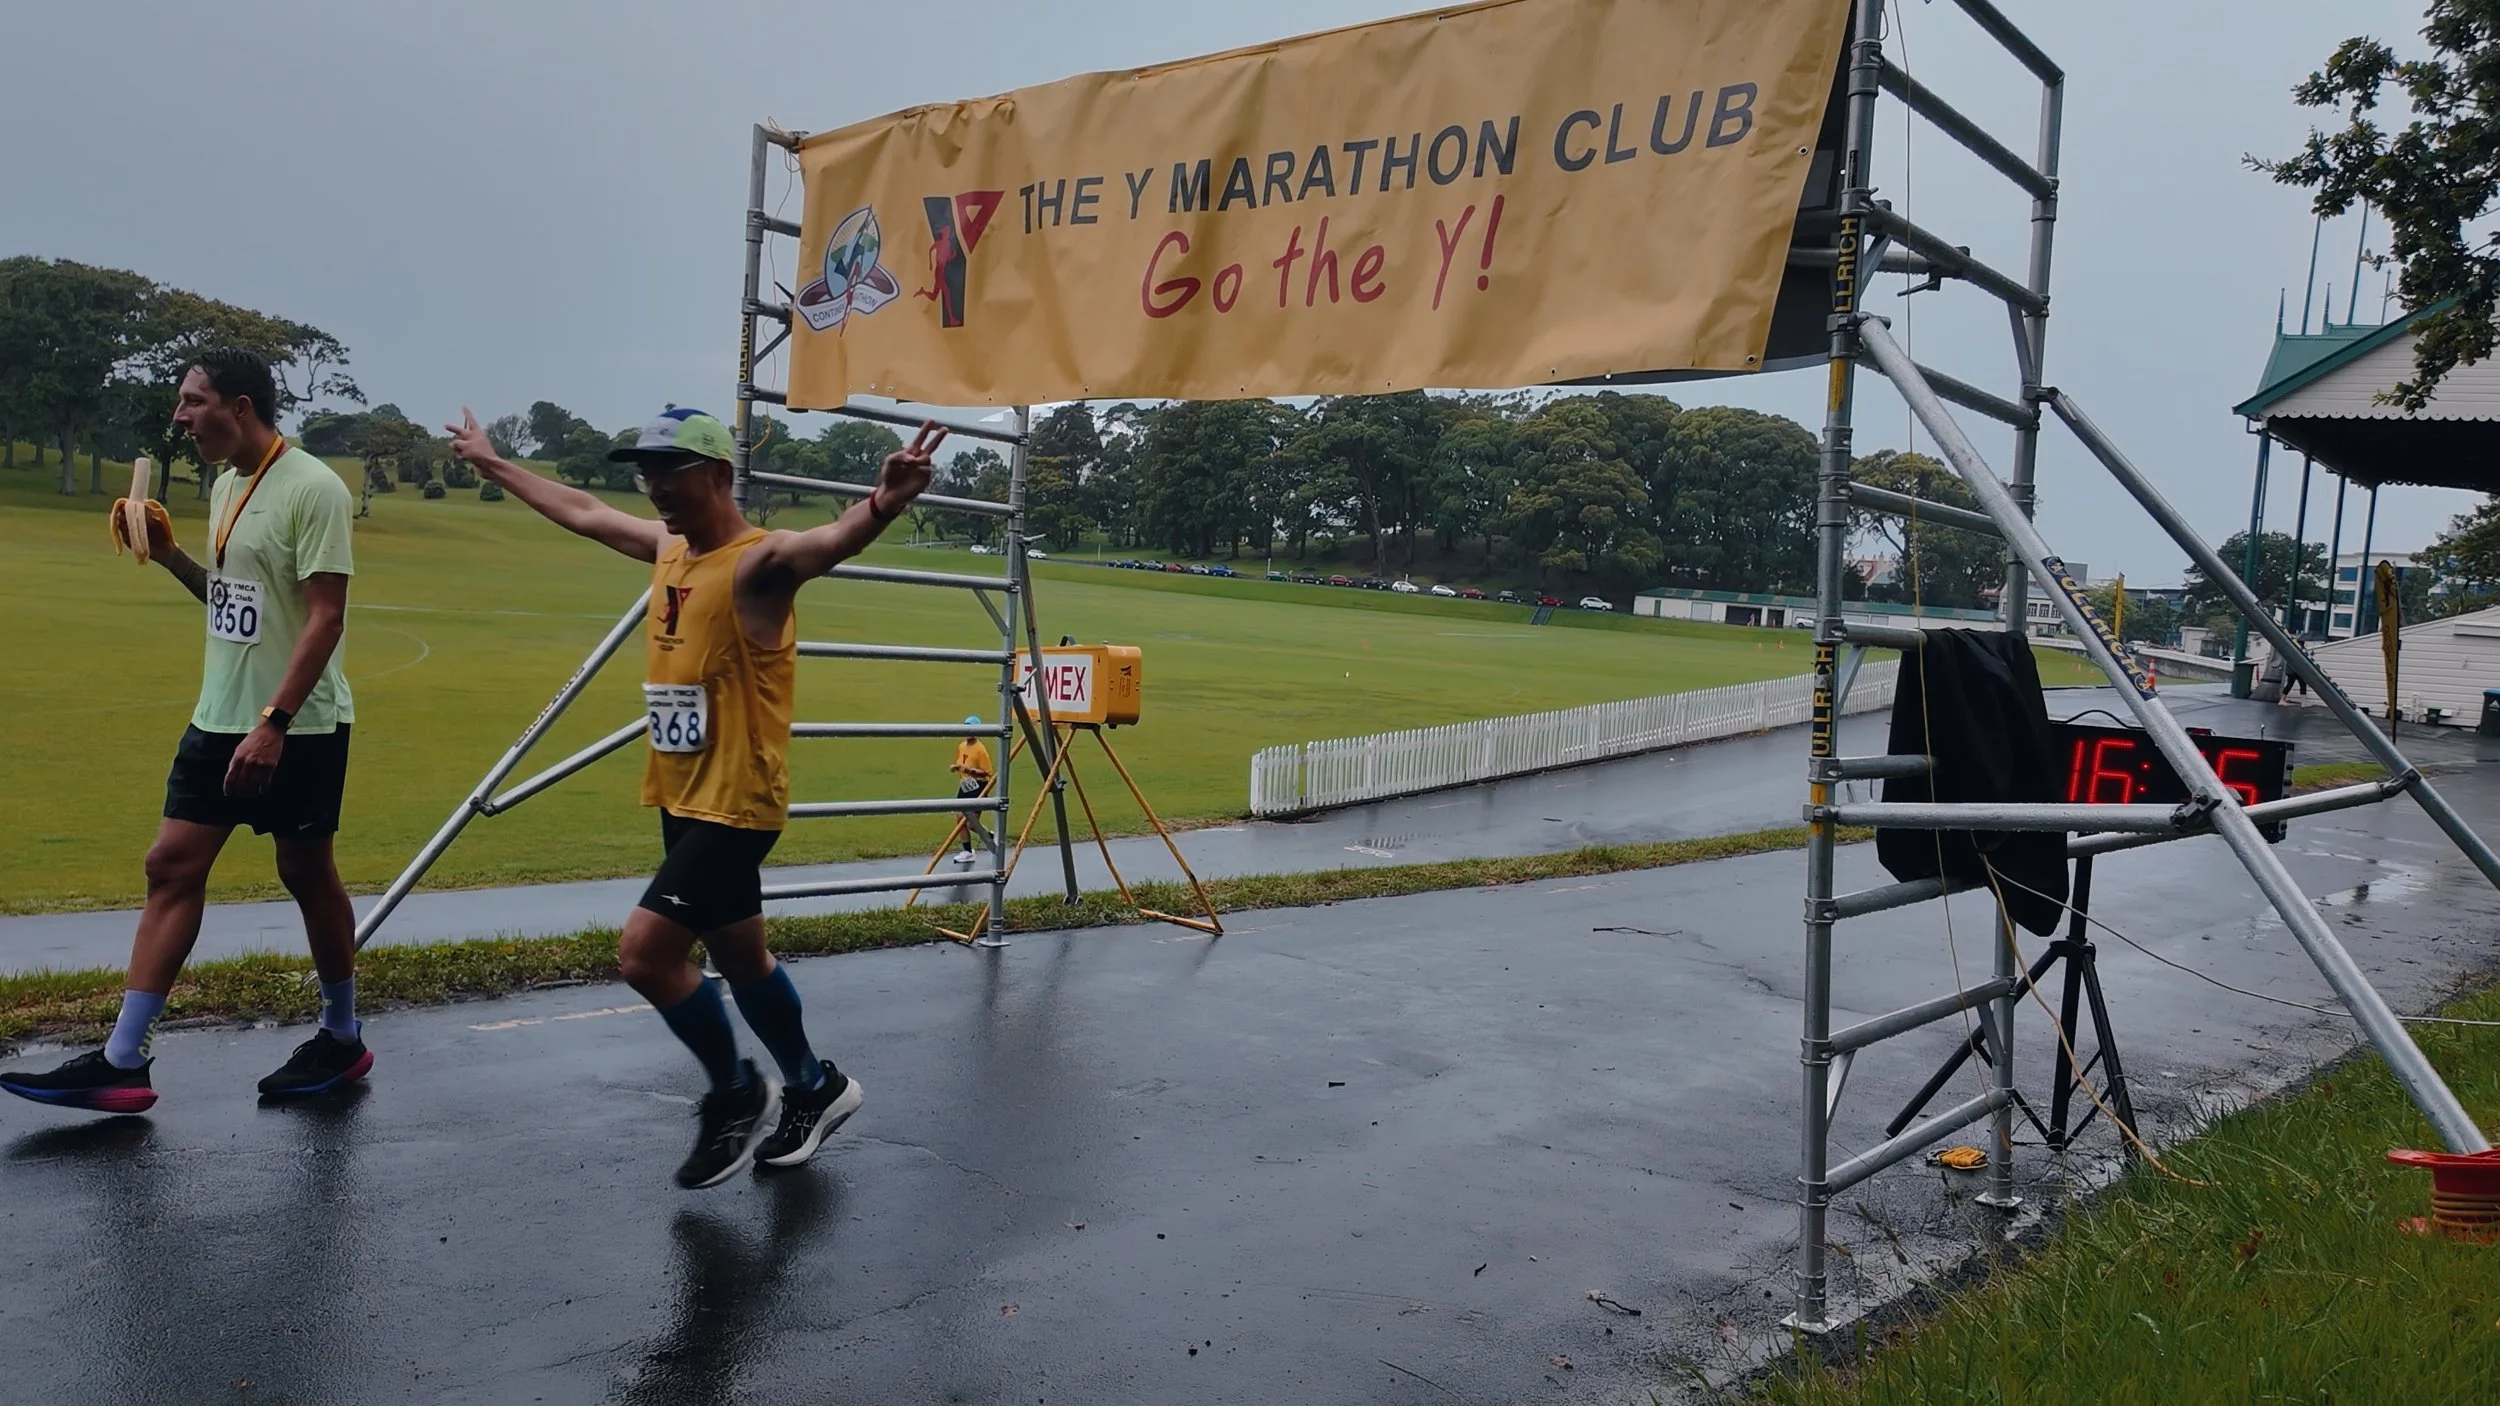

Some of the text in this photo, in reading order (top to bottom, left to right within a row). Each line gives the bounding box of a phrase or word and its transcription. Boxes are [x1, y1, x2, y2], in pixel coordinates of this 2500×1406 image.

[1020, 81, 1758, 235] THE Y MARATHON CLUB
[1141, 194, 1505, 319] Go the Y!
[1833, 217, 1858, 313] LLRICH
[234, 583, 256, 592] YMCA
[235, 594, 253, 602] Club
[1024, 665, 1087, 702] TMEX
[1812, 645, 1834, 756] ULLRCH
